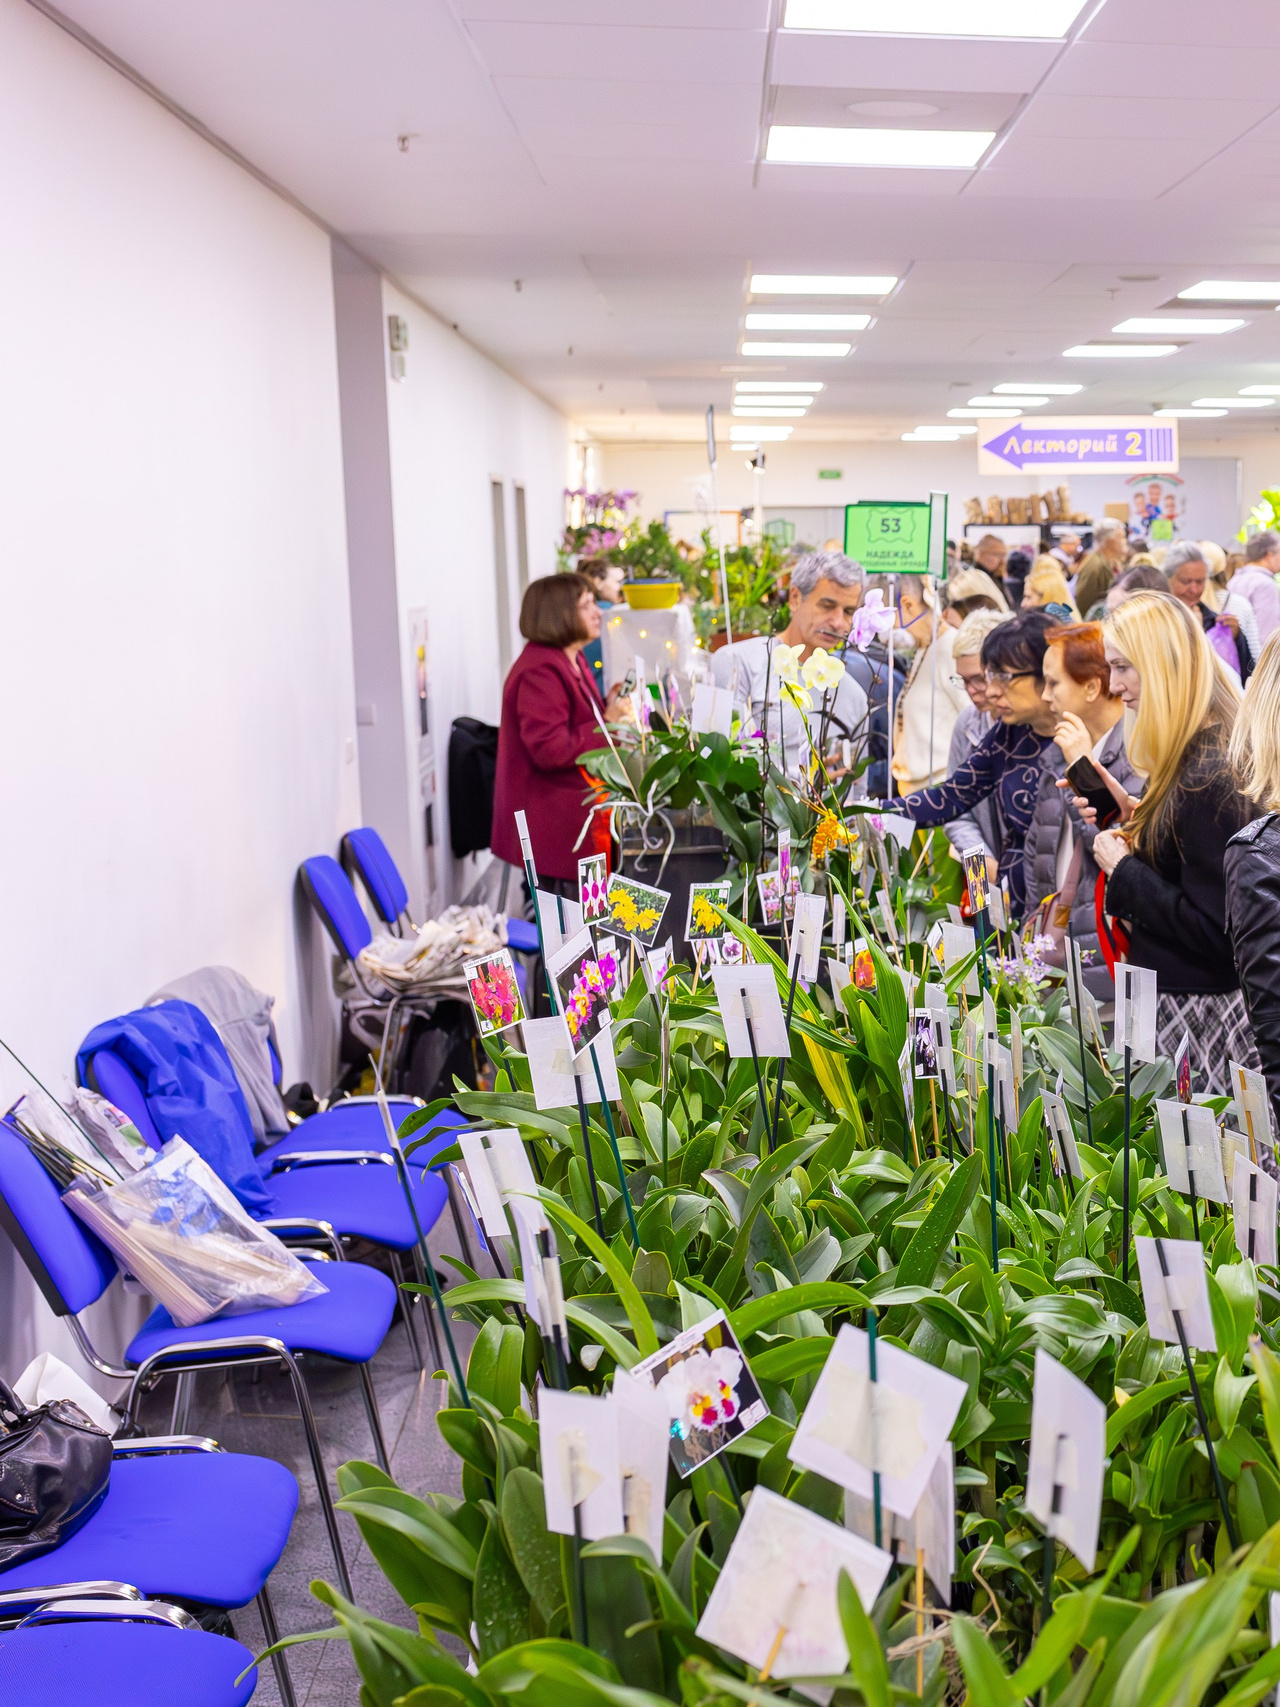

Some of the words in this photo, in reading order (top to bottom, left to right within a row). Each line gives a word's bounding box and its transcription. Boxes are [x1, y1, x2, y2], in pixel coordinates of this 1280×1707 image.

[1003, 434, 1118, 460] Лекторий
[1125, 431, 1142, 456] 2
[881, 518, 901, 533] 53
[866, 550, 914, 559] НАДЕЖДА
